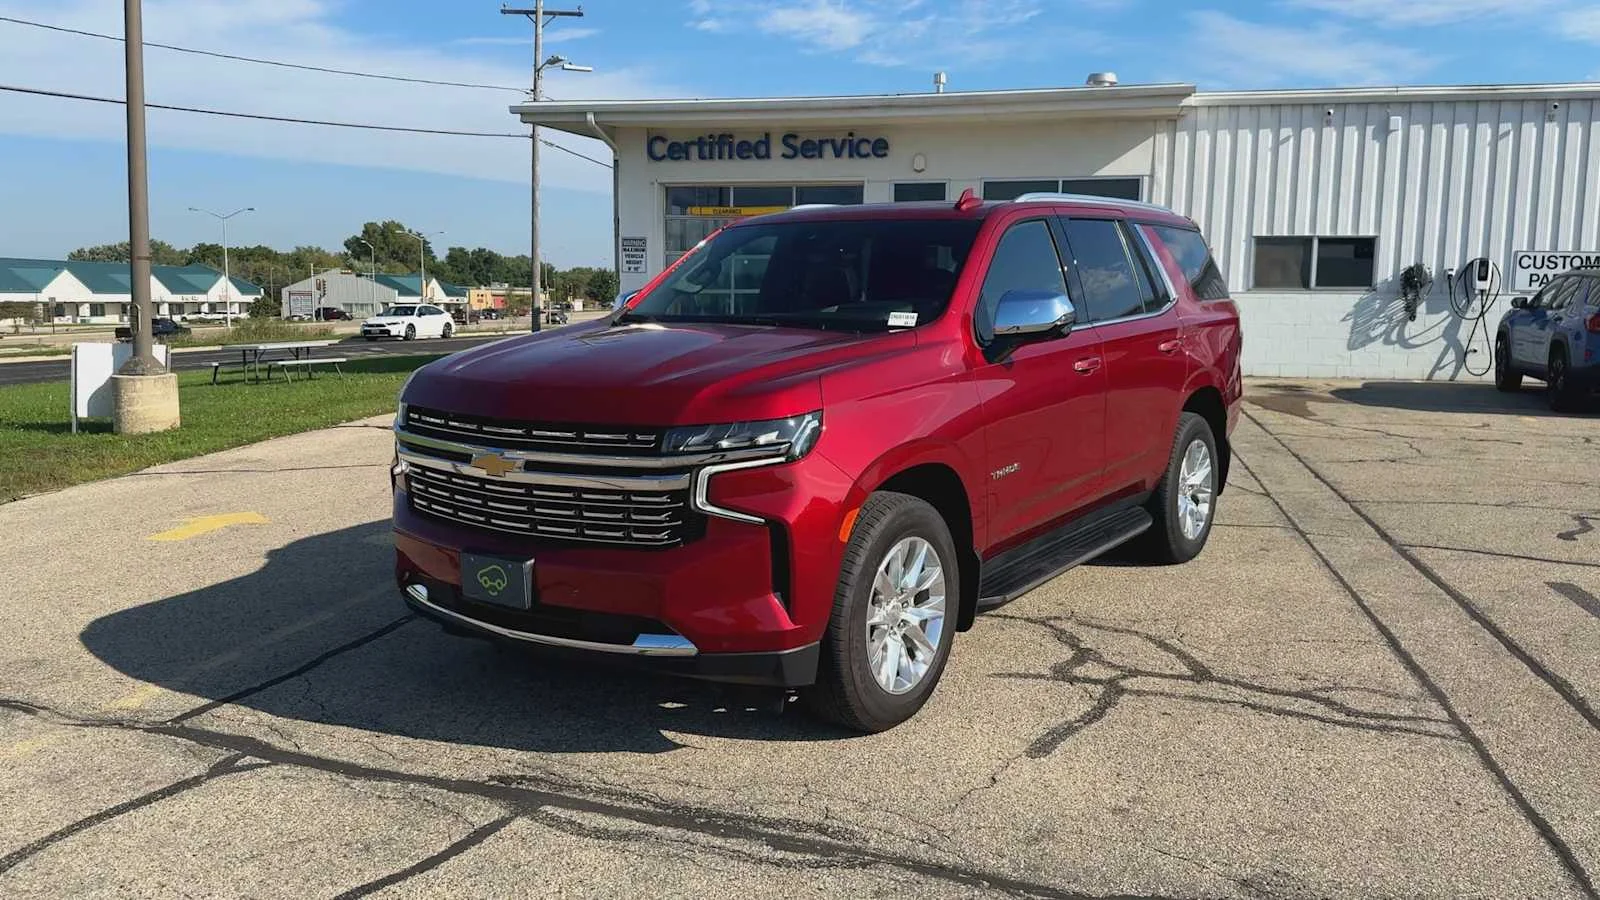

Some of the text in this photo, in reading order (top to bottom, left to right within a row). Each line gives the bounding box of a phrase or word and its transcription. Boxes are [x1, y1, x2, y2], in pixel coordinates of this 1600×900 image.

[648, 132, 889, 161] Certified Service
[623, 239, 646, 247] WARNING
[991, 462, 1021, 480] TAHOE
